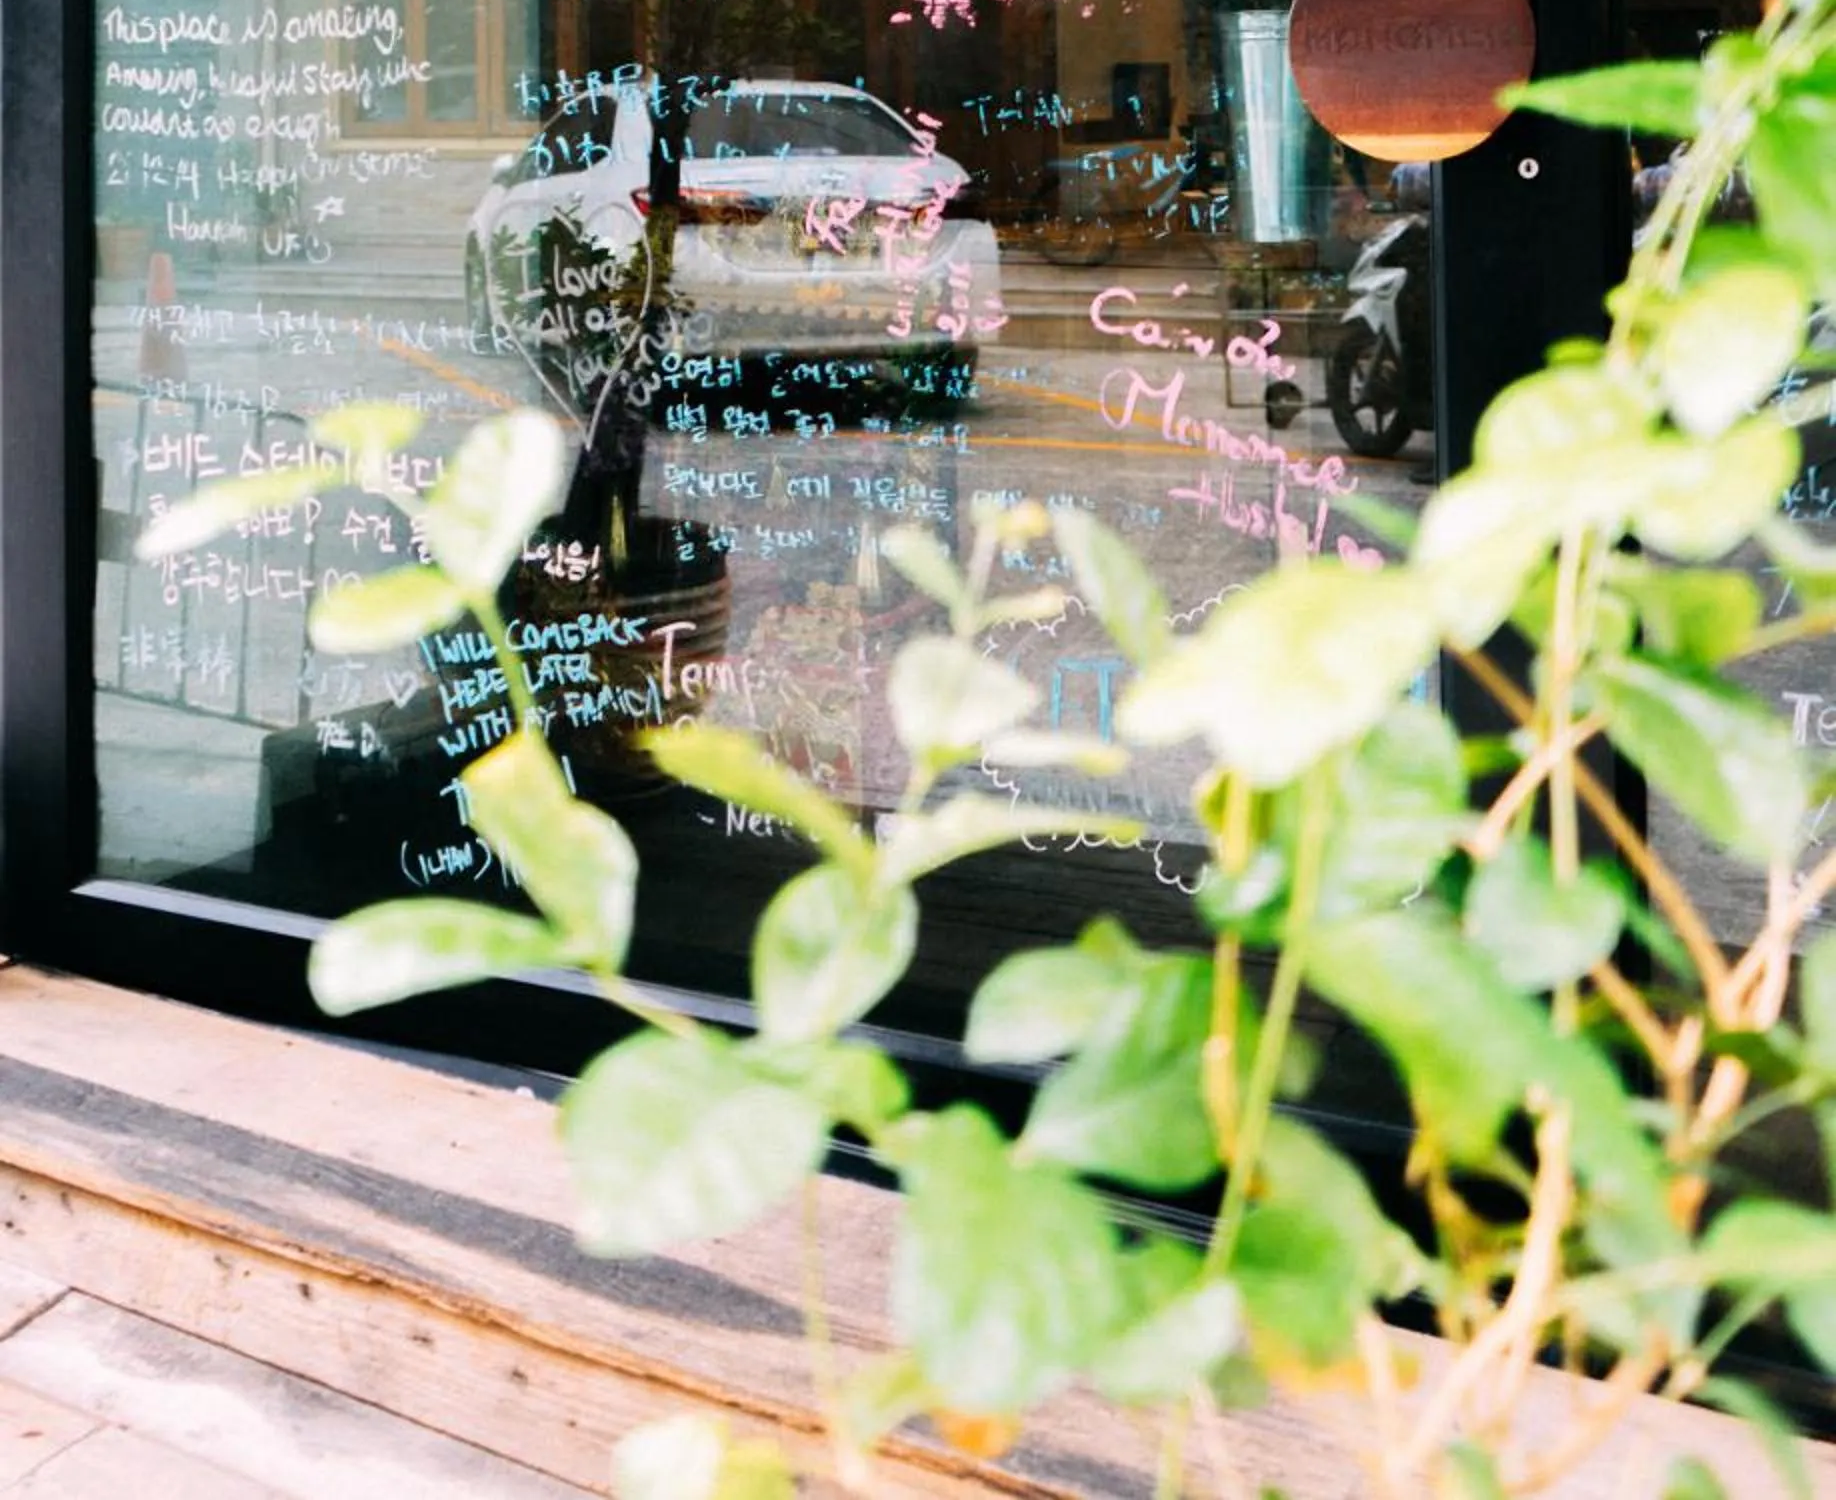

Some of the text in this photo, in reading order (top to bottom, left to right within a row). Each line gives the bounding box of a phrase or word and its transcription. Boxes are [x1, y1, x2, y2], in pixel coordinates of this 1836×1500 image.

[158, 10, 233, 53] place
[553, 244, 624, 298] love
[435, 631, 498, 664] WILL
[438, 652, 599, 725] HERE LATER
[437, 706, 514, 758] WITH
